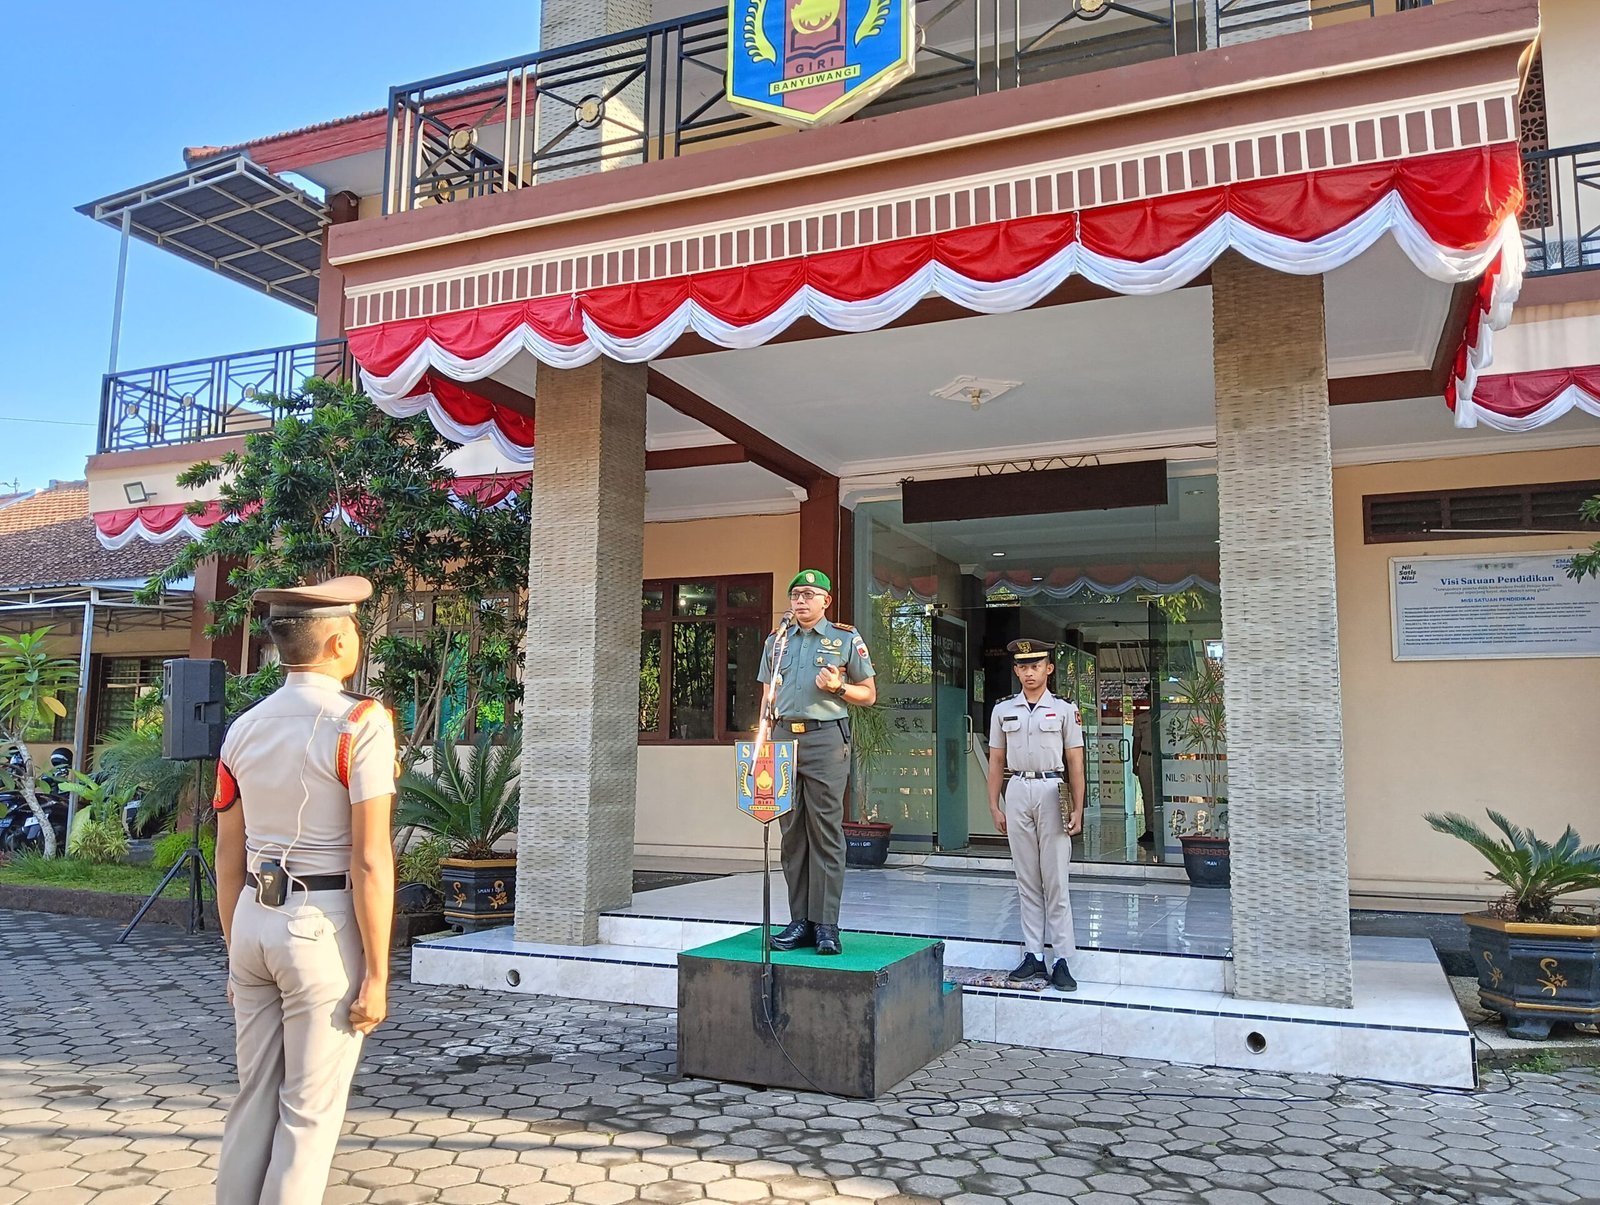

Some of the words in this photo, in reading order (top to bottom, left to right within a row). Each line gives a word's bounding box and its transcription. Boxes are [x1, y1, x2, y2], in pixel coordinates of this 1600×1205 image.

[795, 57, 835, 74] GIRI
[773, 66, 858, 93] BANYUWANGI
[1440, 577, 1459, 586] Visi
[1460, 576, 1495, 585] Satuan
[1497, 574, 1555, 584] Pendidikan
[1165, 773, 1178, 783] NIL
